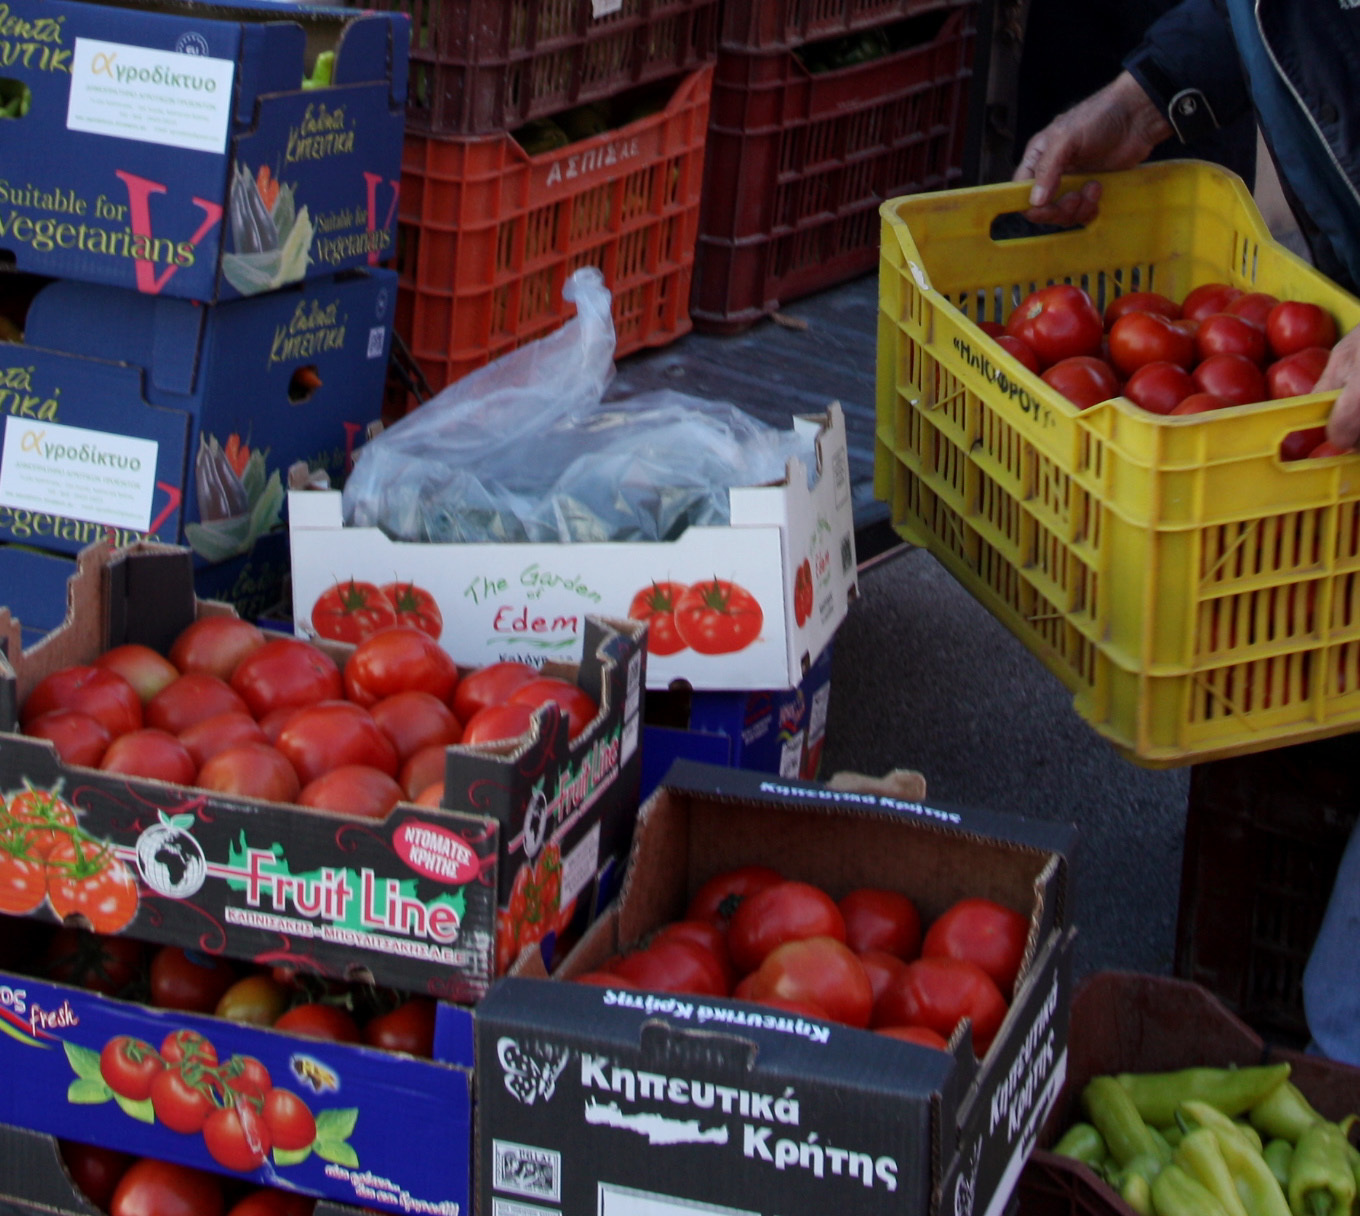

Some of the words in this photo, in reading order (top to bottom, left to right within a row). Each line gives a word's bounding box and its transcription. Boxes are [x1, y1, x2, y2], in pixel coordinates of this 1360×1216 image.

[91, 51, 217, 93] αγροδίκτυο
[546, 143, 618, 187] ΑΣΠΙΣ
[94, 186, 129, 221] for
[20, 429, 142, 472] αγροδίκτυο
[463, 576, 508, 605] The
[520, 562, 602, 604] Garden
[493, 604, 578, 634] Edem
[404, 826, 472, 866] ΝΤΟΜΑΤΕΣ
[409, 844, 459, 879] ΚΡΗΤΗΣ
[246, 846, 354, 923] Fruit
[360, 867, 461, 944] Line
[224, 906, 314, 938] ΚΑΠΝΙΣΑΚΗΣ
[322, 926, 428, 959] ΜΠΟΥΛΙΤΣΑΚΗΣ
[29, 1003, 80, 1037] fresh
[602, 988, 694, 1024] Κρήτης
[697, 1008, 831, 1045] Κηπευτικά
[580, 1053, 800, 1126] Κηπευτικά
[743, 1124, 899, 1191] Κρήτης
